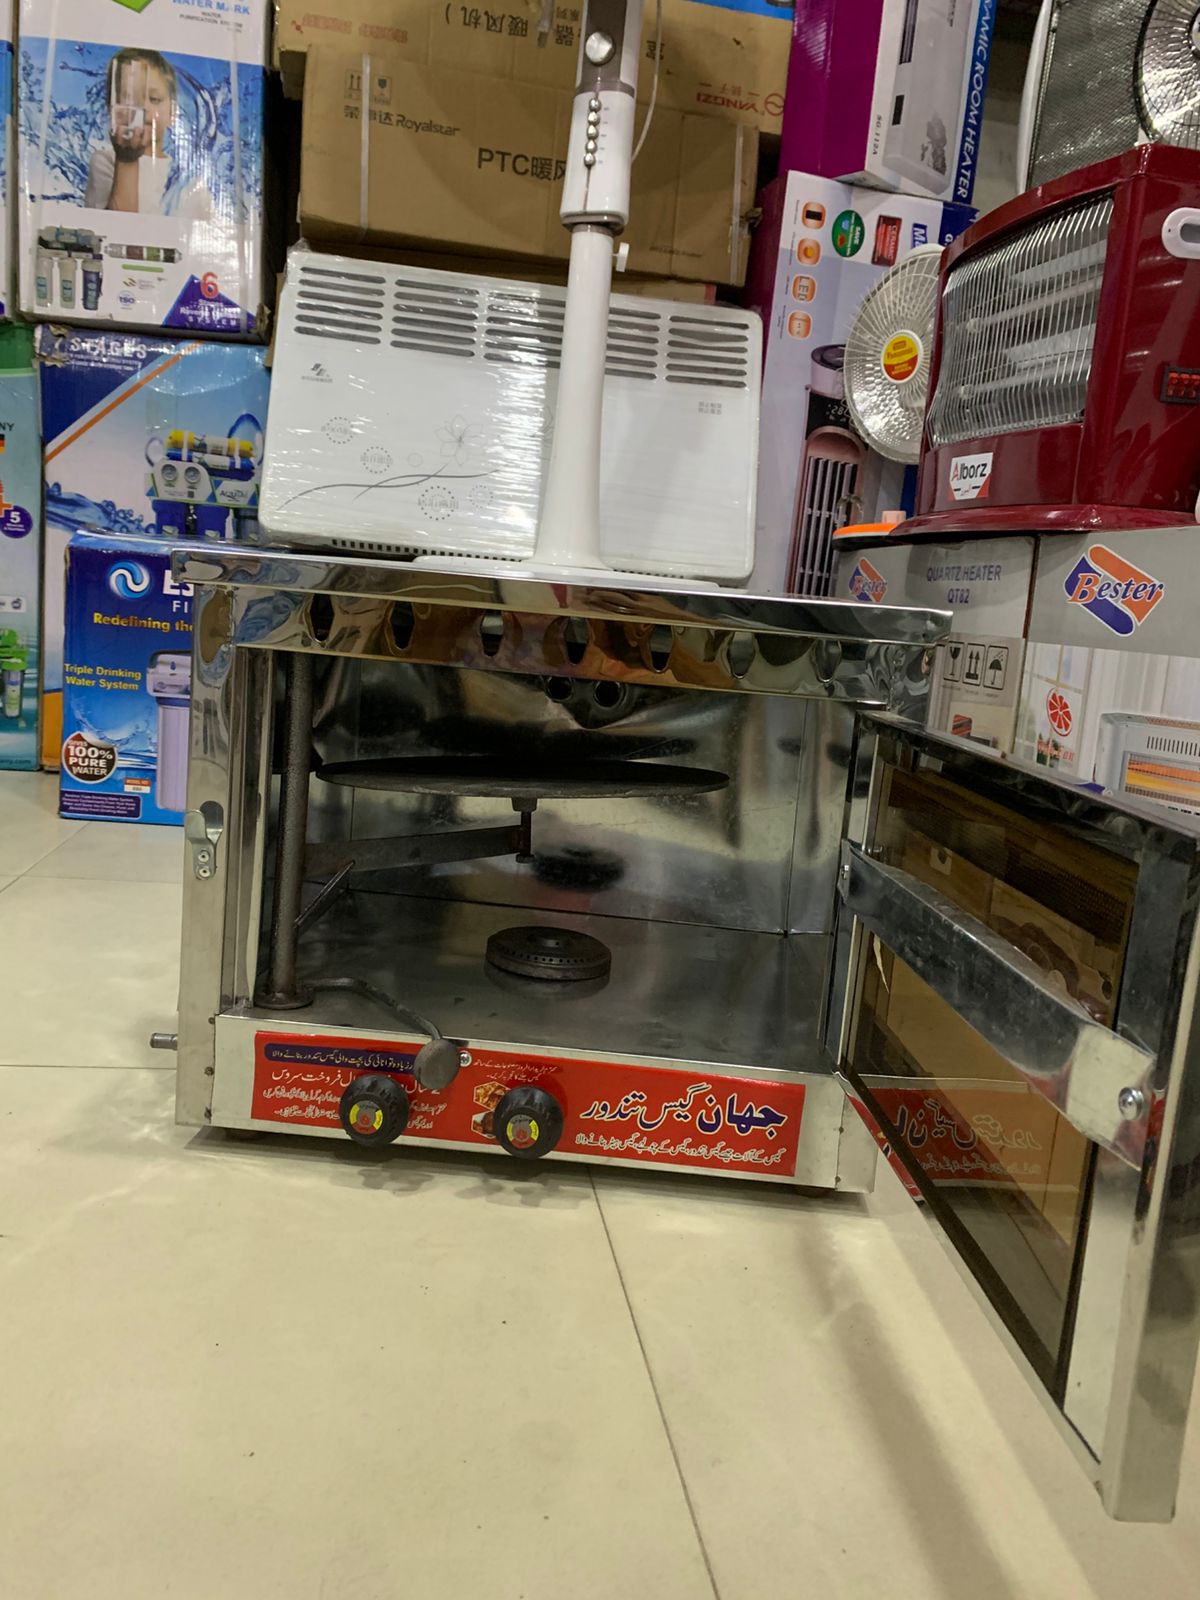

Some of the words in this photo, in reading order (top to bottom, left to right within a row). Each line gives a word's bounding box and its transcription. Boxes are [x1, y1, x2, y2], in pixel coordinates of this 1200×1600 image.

[172, 0, 213, 9] TER
[215, 2, 250, 15] MRK
[968, 61, 985, 125] ROOM
[395, 112, 461, 136] Royalstar
[956, 126, 976, 199] HEATER
[201, 271, 219, 299] 6
[951, 462, 988, 481] Alborz
[10, 511, 21, 523] 5
[926, 566, 962, 582] QUARTZ
[963, 564, 1002, 581] HEATER
[1066, 571, 1165, 604] Bester
[93, 611, 171, 633] Redefining
[64, 663, 94, 675] Triple
[96, 666, 142, 681] Drinking
[65, 676, 97, 687] Water
[99, 678, 139, 690] System
[68, 745, 113, 760] 100%
[68, 756, 107, 768] PURE
[72, 766, 107, 776] WATER
[271, 1068, 302, 1084] سروس
[301, 1069, 341, 1086] فروخت
[579, 1090, 647, 1120] تندور
[638, 1081, 712, 1131] گیس
